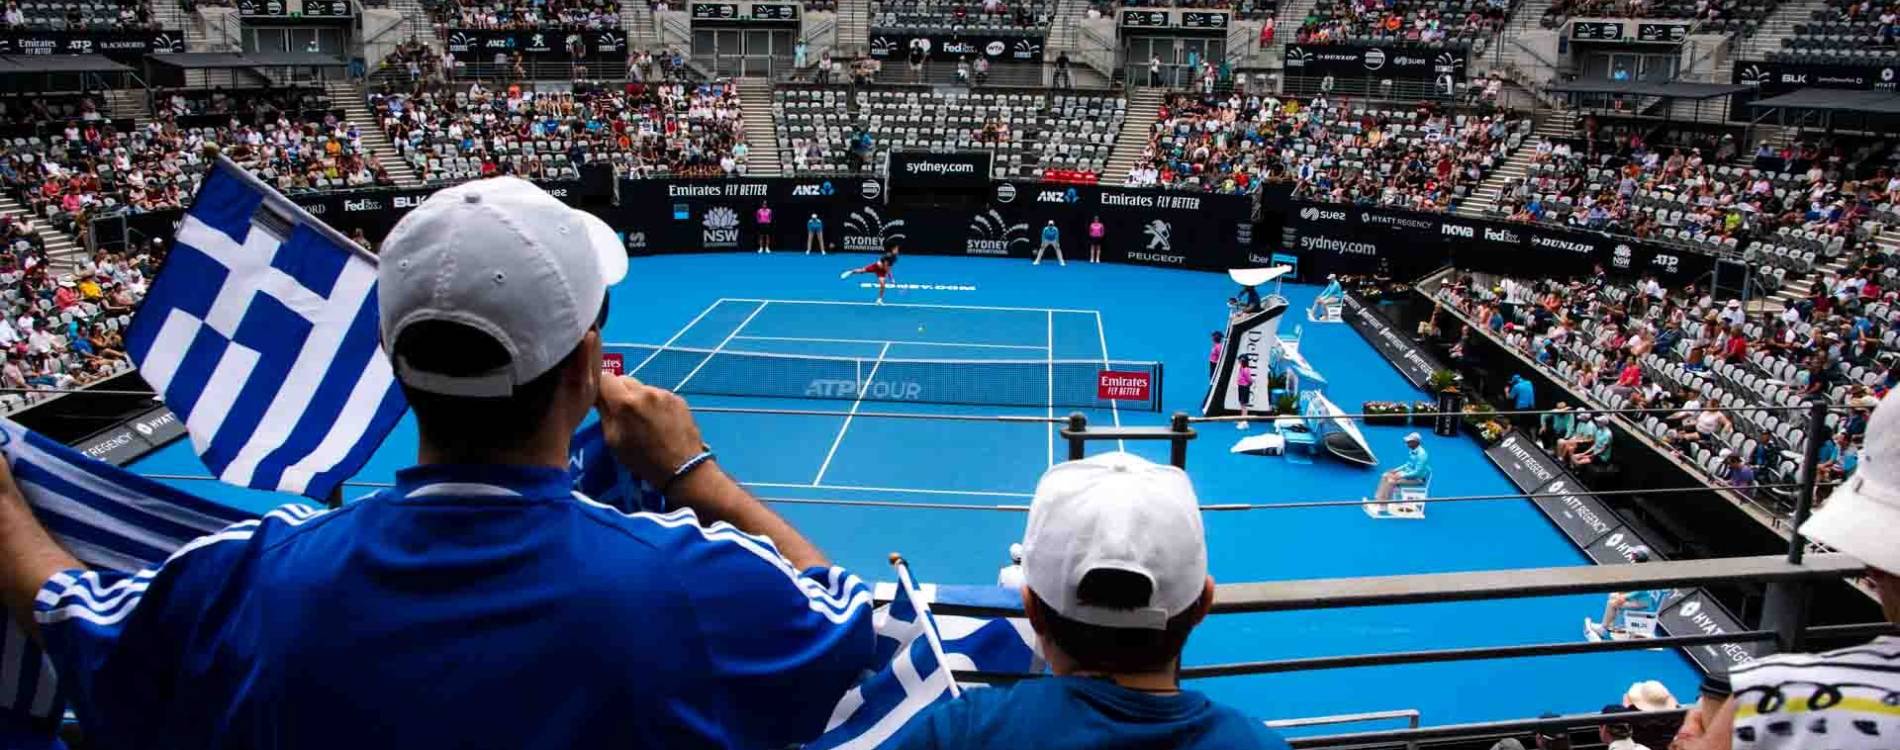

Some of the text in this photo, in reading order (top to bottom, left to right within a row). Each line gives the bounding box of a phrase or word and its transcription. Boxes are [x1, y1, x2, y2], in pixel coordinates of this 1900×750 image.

[906, 160, 974, 174] sydney.com
[669, 184, 767, 196] Emirates FLY BETTER
[792, 184, 820, 196] ANZ
[1037, 190, 1064, 203] ANZ
[1101, 192, 1200, 210] Emirates FLY BETTER
[1397, 218, 1433, 229] REGENCY
[703, 230, 739, 242] NSW
[1441, 223, 1474, 238] nova
[843, 236, 885, 246] SYDNEY
[967, 239, 1009, 249] SYDNEY
[1300, 235, 1376, 255] sydney.com
[1541, 237, 1594, 254] DUNLOP
[1127, 251, 1186, 264] PEUGEOT
[1101, 376, 1148, 388] Emirates
[1508, 440, 1554, 481] HYATT REGENCY
[1576, 506, 1612, 534] REGENCY
